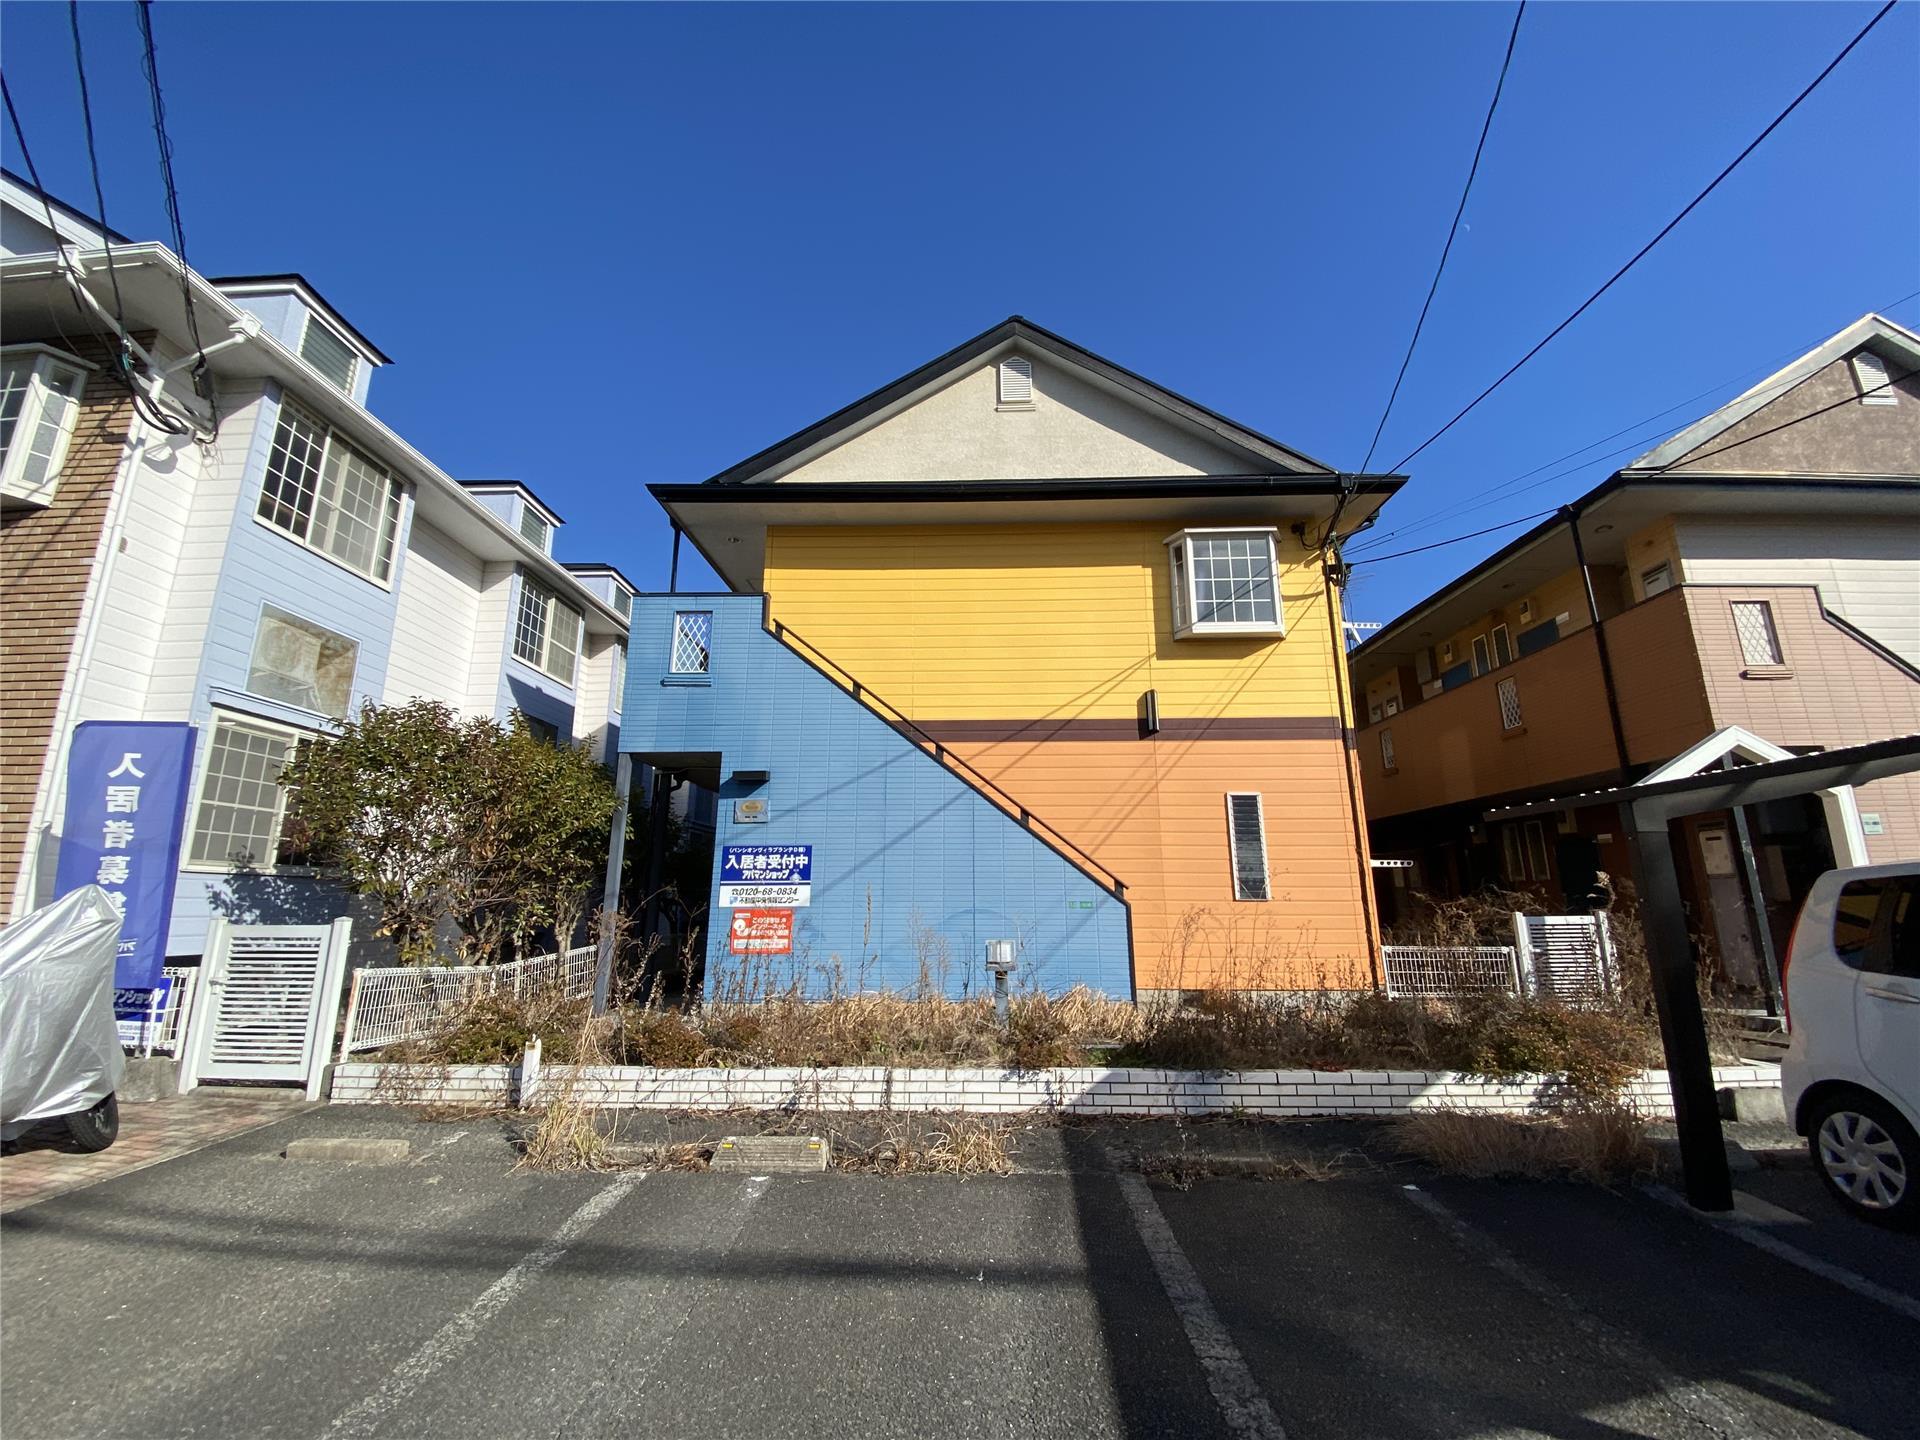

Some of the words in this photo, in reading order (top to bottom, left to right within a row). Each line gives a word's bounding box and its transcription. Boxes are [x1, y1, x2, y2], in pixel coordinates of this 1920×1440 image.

[725, 854, 809, 869] 入居者受付中
[742, 869, 790, 879] アパマンショップ
[738, 887, 798, 896] 0120-68-0834
